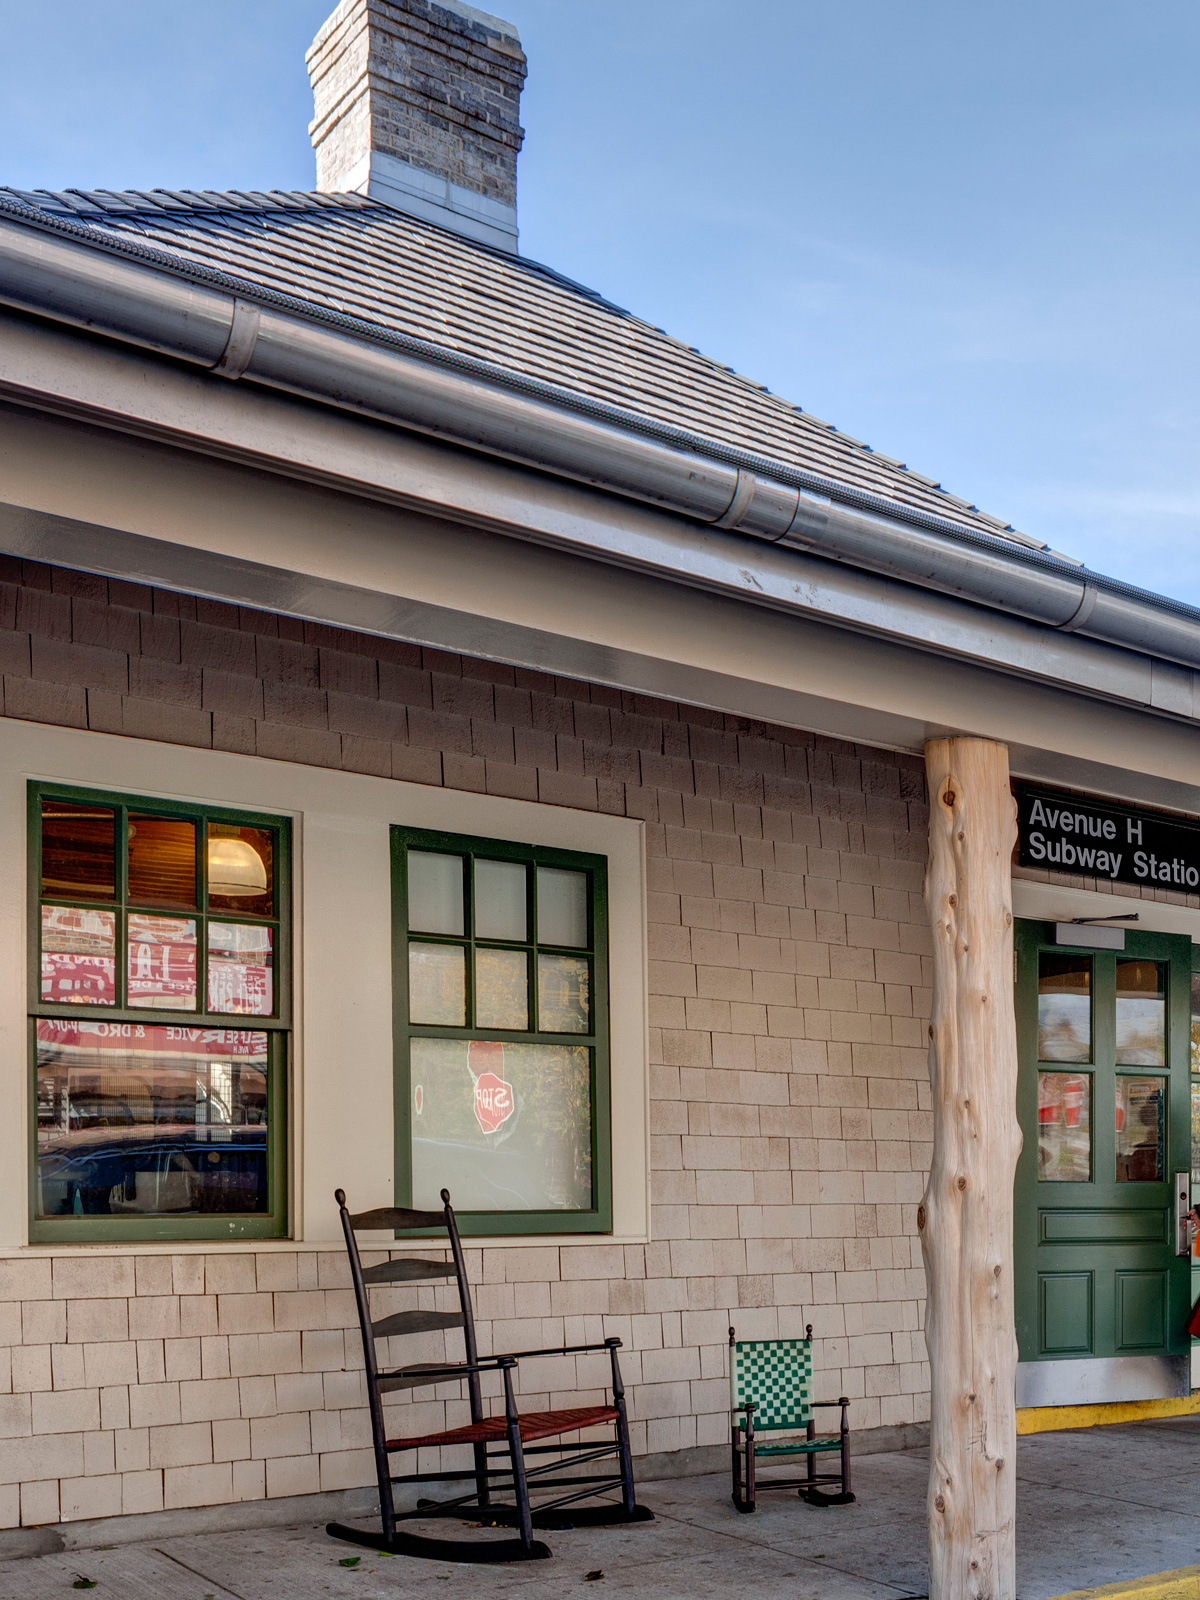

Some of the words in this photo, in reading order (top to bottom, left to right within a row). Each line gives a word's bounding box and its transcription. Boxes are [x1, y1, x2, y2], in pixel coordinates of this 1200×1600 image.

[1029, 800, 1117, 840] Avenue
[1127, 818, 1143, 845] H
[1029, 832, 1122, 878] Subway
